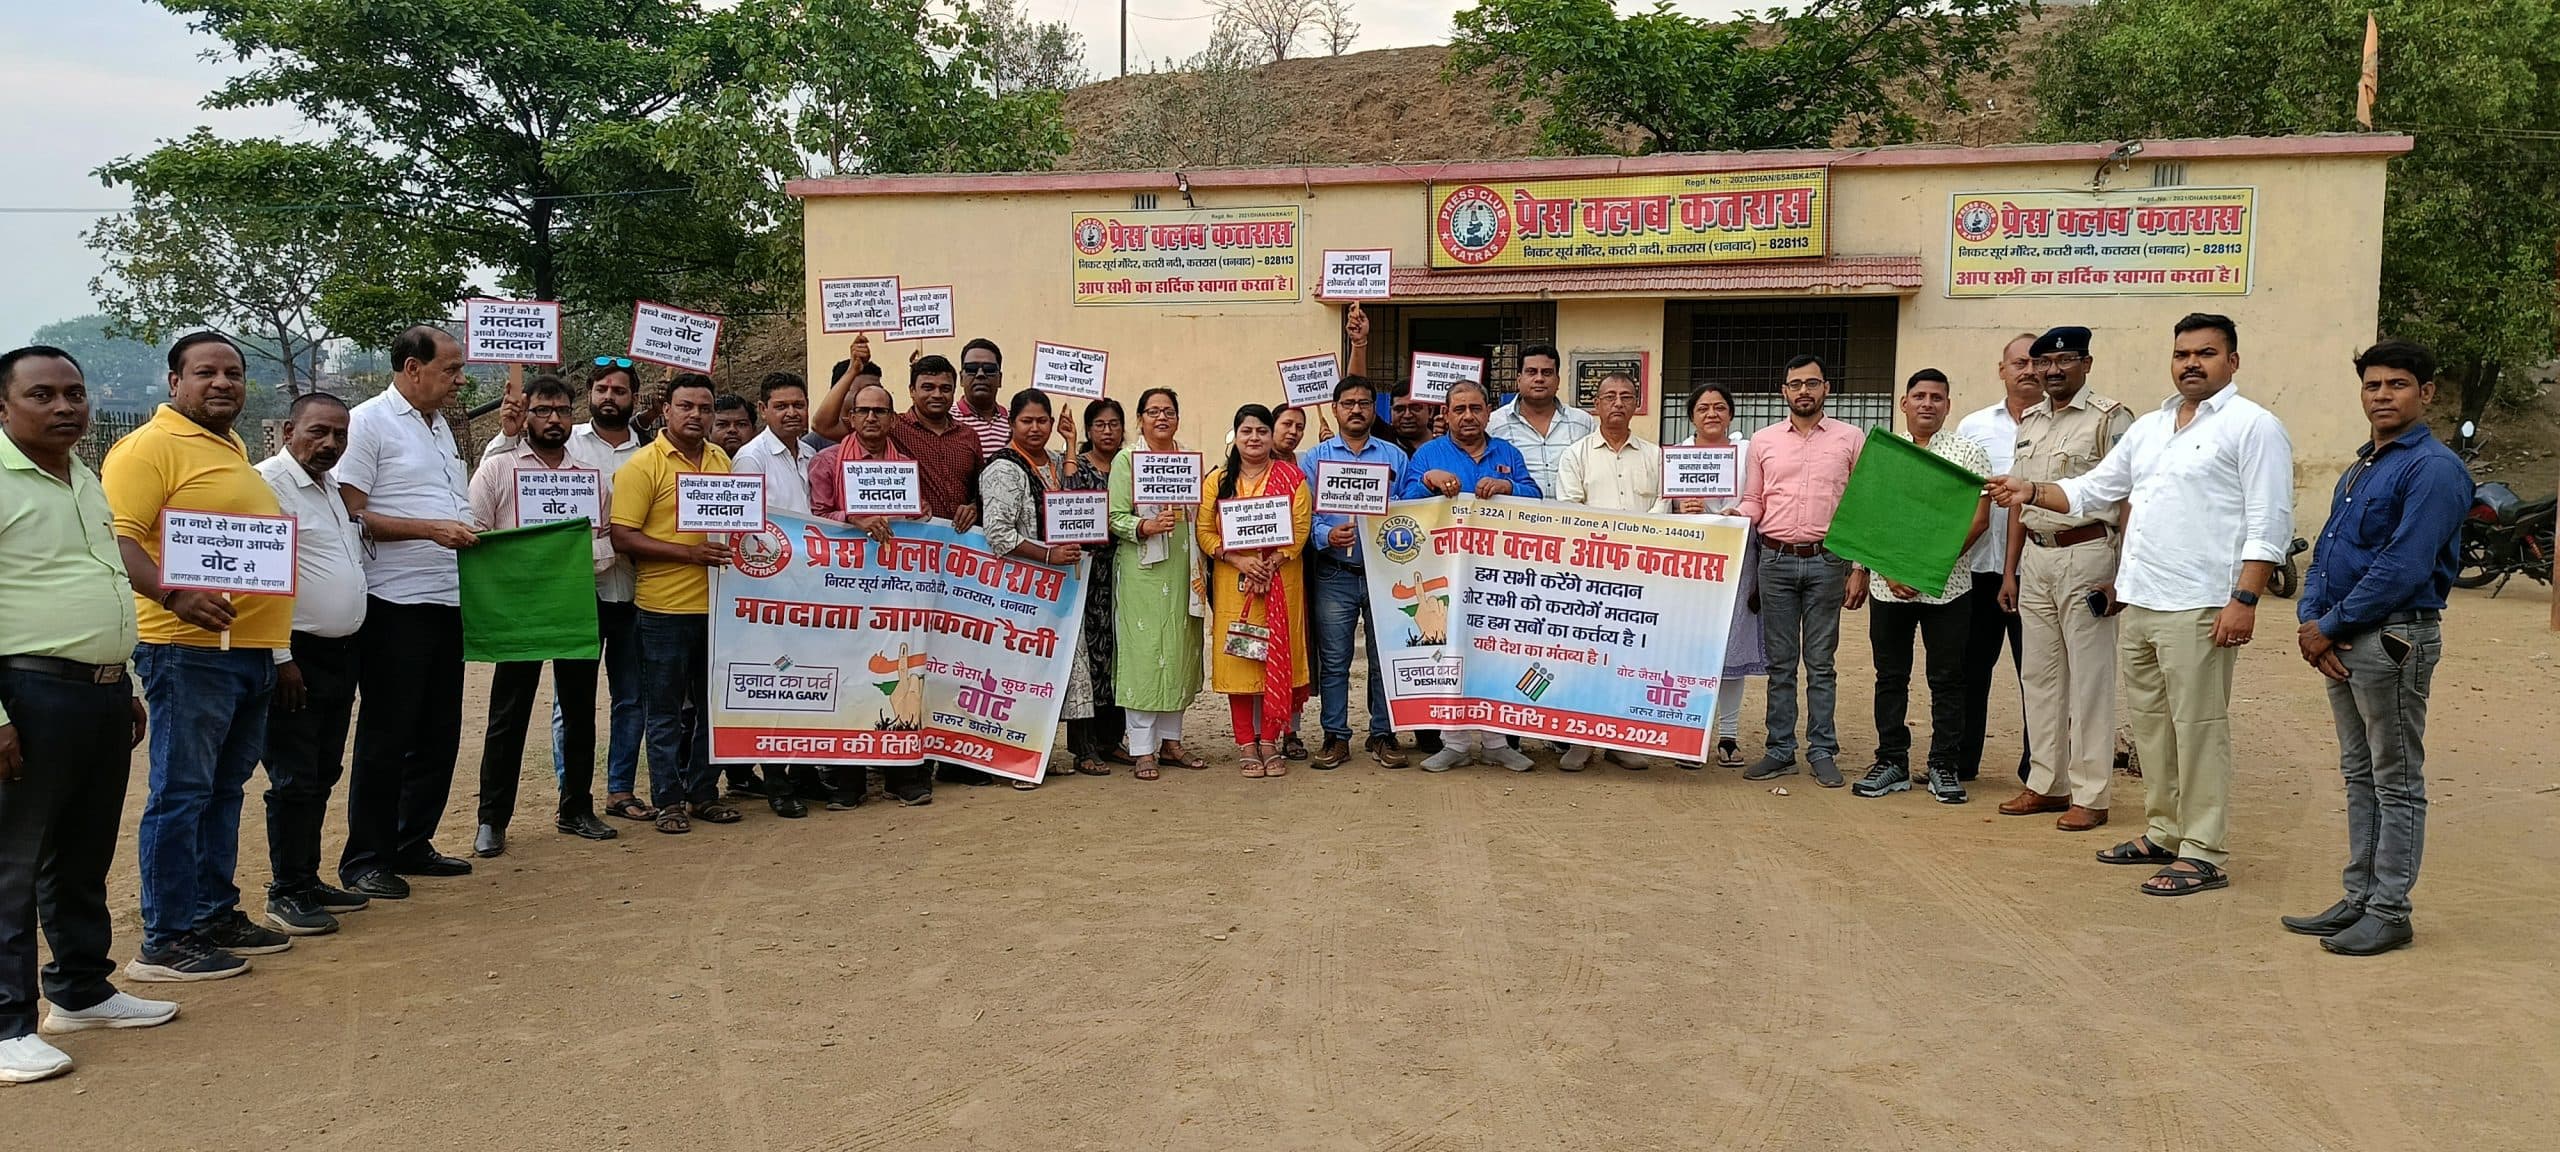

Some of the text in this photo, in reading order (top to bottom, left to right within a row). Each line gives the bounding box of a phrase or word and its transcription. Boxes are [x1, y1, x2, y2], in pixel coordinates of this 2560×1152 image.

[1441, 188, 1507, 220] PRESS CLUB
[1513, 187, 1816, 237] प्रेस क्लब कतरास
[2000, 202, 2244, 237] प्रेस क्लब कतरास
[1109, 219, 1294, 252] प्रेस क्लब कतरास
[1450, 243, 1498, 262] KATRAS
[1524, 237, 1809, 260] निकट सूर्य कतरी नदी, कतरास 828113
[1959, 244, 2242, 260] निकट सूर्य कतरी कतरास 828113
[1078, 258, 1101, 269] निकट
[1143, 257, 1164, 268] कतरी
[1186, 258, 1217, 268] कतरास
[1264, 256, 1294, 265] 828113
[1332, 263, 1382, 275] मतदान
[1956, 265, 2215, 285] आप सभी का हार्दिक स्वागत करता
[1078, 276, 1275, 294] आप सभी का हार्दिक स्वागत करता
[483, 305, 496, 314] 25
[517, 307, 530, 315] को
[864, 307, 882, 318] वोट
[479, 315, 546, 328] मतदान
[651, 324, 703, 342] पहले वोट
[479, 338, 546, 351] मतदान
[1069, 359, 1093, 374] वोट
[1296, 380, 1328, 393] मतदान
[1142, 464, 1192, 474] मतदान
[1327, 475, 1380, 491] मतदान
[1679, 472, 1720, 483] मतदान
[740, 491, 756, 501] करें
[858, 488, 906, 501] मतदान
[1142, 483, 1192, 494] मतदान
[1353, 491, 1364, 502] की
[542, 498, 578, 514] वोट से
[697, 503, 744, 516] मतदान
[1059, 518, 1095, 530] मतदान
[1385, 517, 1414, 529] LIONS
[1452, 506, 1471, 515] Dist.
[1480, 507, 1504, 519] 322A
[1518, 511, 1552, 523] Region
[1562, 516, 1571, 525] III
[1574, 518, 1599, 528] Zone
[1601, 520, 1609, 529] A
[170, 517, 287, 535] ना नशे से ना नोट से
[1236, 523, 1277, 536] मतदान
[172, 531, 285, 551] देश आपके
[1394, 530, 1409, 548] L
[201, 550, 256, 573] वोट से
[803, 525, 1067, 602] प्रेस क्लब कतरास
[1502, 531, 1729, 582] क्लब ऑफ कतरास
[740, 562, 777, 577] KATRAS
[233, 575, 243, 584] की
[1475, 566, 1644, 600] हम सभी करेंगे मतदान
[825, 573, 856, 588] नियर
[858, 575, 879, 594] सूर्य
[952, 586, 995, 608] कतरास,
[1486, 590, 1517, 609] सभी
[1520, 594, 1542, 611] को
[1604, 606, 1659, 627] मतदान
[735, 597, 1059, 658] मतदाता रैली
[1466, 613, 1484, 628] यह
[1487, 615, 1511, 631] हम
[1514, 617, 1546, 635] सबों
[1547, 623, 1569, 638] का
[1622, 628, 1636, 648] है
[1473, 635, 1599, 666] यही देश का मंतव्य है
[926, 656, 983, 682] वोट जैसा
[1397, 666, 1435, 682] चुनाव
[1616, 665, 1662, 681] वोट जैसा
[733, 673, 833, 692] चुनाव का पर्व
[1001, 677, 1055, 698] कुछ नही
[1414, 678, 1436, 686] DESH
[1676, 675, 1717, 689] कुछ नही
[748, 689, 828, 701] DESH KA GARV
[1467, 702, 1669, 747] की तिथि 25.05.2024
[1686, 713, 1701, 723] हम
[968, 719, 1028, 743] डालेंगे हम
[756, 733, 920, 754] मतदान की तिथि
